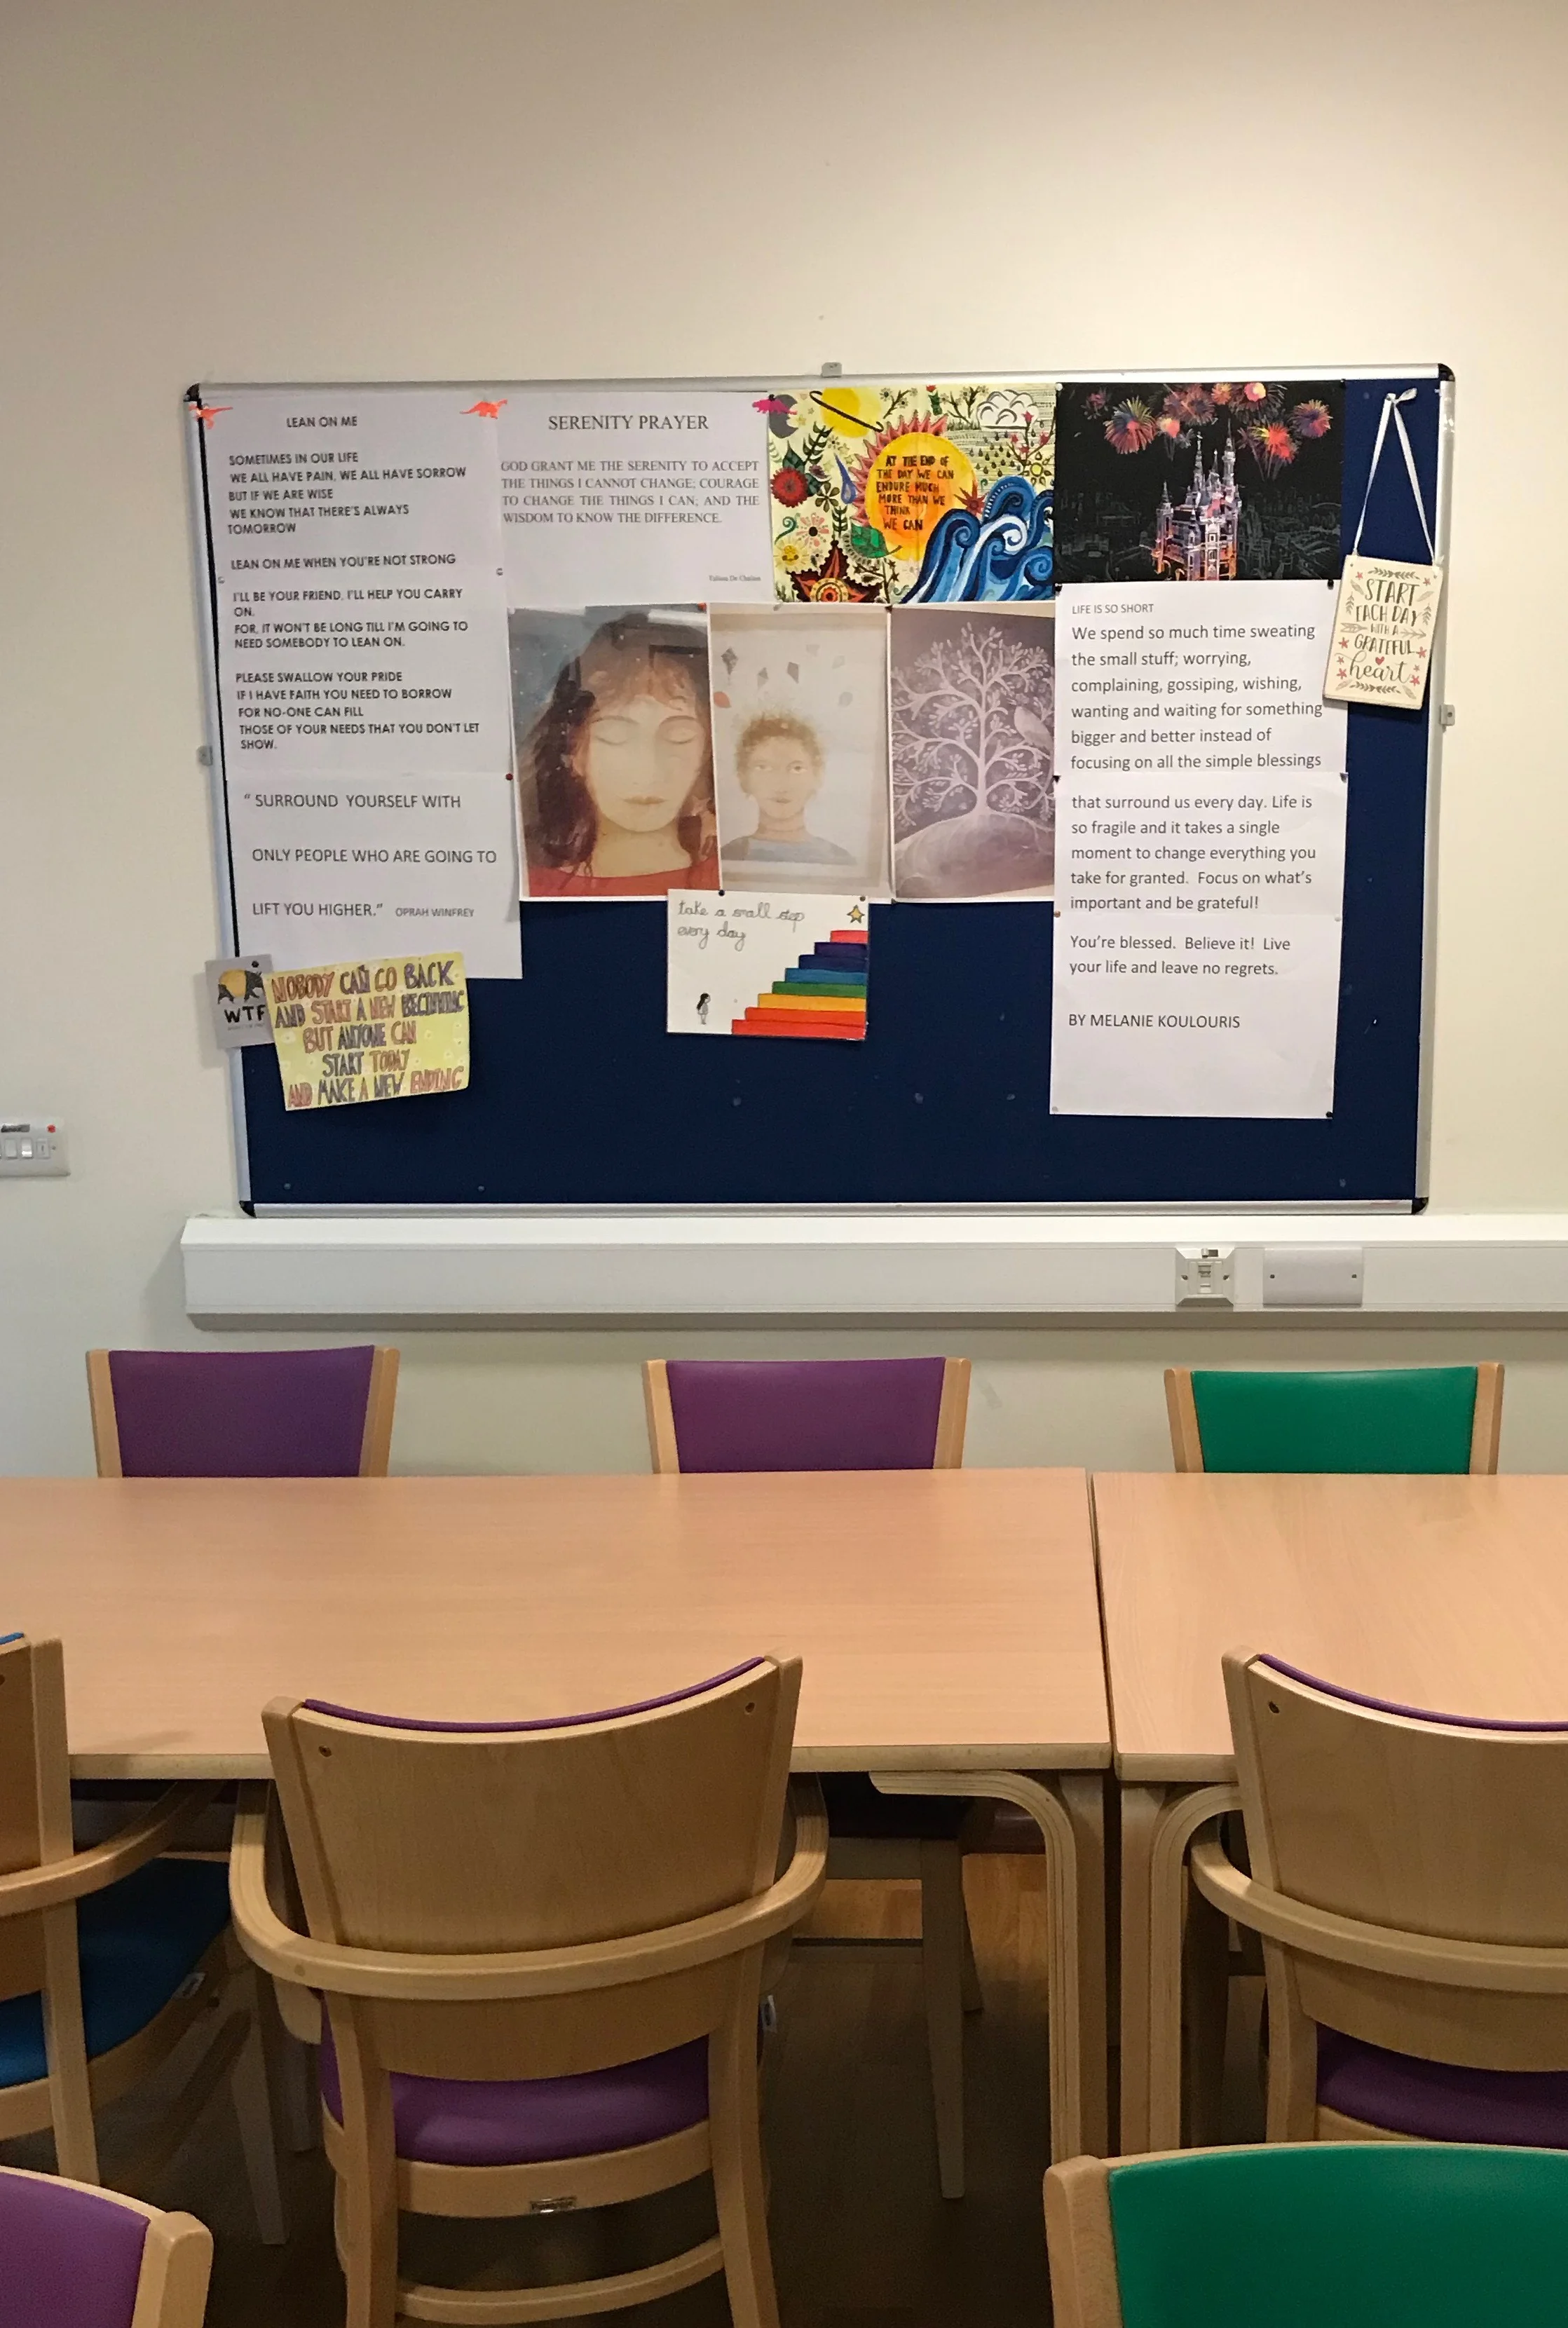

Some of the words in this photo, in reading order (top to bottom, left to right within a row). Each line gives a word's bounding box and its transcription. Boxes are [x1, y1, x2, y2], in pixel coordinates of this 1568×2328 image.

[287, 416, 315, 428] LEAN
[318, 416, 337, 427] ON
[341, 416, 357, 426] ME
[549, 415, 633, 430] SERENITY
[639, 415, 709, 429] PRAYER
[229, 454, 292, 465] SOMETIMES
[295, 454, 307, 463] IN
[311, 453, 334, 463] OUR
[338, 451, 358, 462] LIFE
[500, 461, 528, 471] GOD
[531, 461, 573, 471] GRANT
[577, 461, 595, 470] ME
[599, 461, 622, 470] THE
[627, 461, 686, 470] SERENITY
[691, 461, 708, 470] TO
[711, 461, 758, 471] ACCEPT
[885, 455, 897, 467] AT
[902, 455, 917, 467] THE
[920, 455, 935, 466] END
[940, 456, 949, 467] OF
[877, 469, 892, 479] THE
[897, 469, 913, 479] DAY
[917, 469, 931, 479] WE
[936, 470, 954, 479] CAN
[501, 478, 524, 489] THE
[529, 478, 574, 488] THINGS
[578, 478, 581, 488] I
[585, 478, 636, 488] CANNOT
[699, 478, 758, 488] COURAGE
[876, 482, 910, 493] ENDURE
[915, 482, 939, 492] MUCH
[878, 493, 902, 504] MORE
[908, 494, 929, 505] THAN
[933, 495, 945, 506] WE
[503, 513, 553, 523] WISDOM
[557, 512, 573, 523] TO
[576, 512, 613, 522] KNOW
[617, 512, 641, 522] THE
[885, 505, 911, 516] THINK
[882, 517, 897, 531] WE
[903, 519, 923, 531] CAN
[231, 559, 259, 569] LEAN
[262, 558, 280, 569] ON
[283, 558, 300, 569] ME
[303, 557, 336, 568] WHEN
[339, 556, 380, 567] YOU'RE
[383, 554, 407, 565] NOT
[409, 553, 456, 565] STRONG
[1365, 578, 1420, 606] START
[1072, 605, 1091, 614] LIFE
[1094, 604, 1102, 613] IS
[1105, 604, 1118, 613] SO
[1121, 604, 1154, 613] SHORT
[1356, 604, 1388, 622] EACH
[1391, 606, 1422, 627] DAY
[1072, 627, 1096, 639] We
[1100, 625, 1143, 642] spend
[1148, 629, 1164, 639] so
[1169, 625, 1208, 638] much
[1213, 625, 1246, 638] time
[1250, 624, 1315, 640] sweating
[1370, 623, 1390, 635] WITH
[1392, 625, 1399, 636] A
[235, 638, 263, 648] NEED
[266, 637, 329, 648] SOMEBODY
[333, 637, 348, 647] TO
[351, 637, 380, 647] LEAN
[1354, 634, 1417, 655] GRATEFUL
[1071, 652, 1095, 666] the
[1100, 652, 1136, 665] small
[1141, 651, 1178, 667] stuff;
[1183, 651, 1250, 667] worrying,
[1337, 650, 1412, 683] heart
[236, 672, 274, 683] PLEASE
[277, 672, 333, 683] SWALLOW
[336, 672, 367, 682] YOUR
[371, 672, 402, 681] PRIDE
[1071, 678, 1162, 695] complaining,
[1167, 677, 1237, 694] gossiping,
[1243, 676, 1301, 692] wishing,
[1071, 704, 1129, 721] wanting
[1133, 703, 1159, 717] and
[1164, 703, 1216, 719] waiting
[1221, 702, 1241, 716] for
[1246, 701, 1322, 718] something
[1071, 730, 1115, 747] bigger
[1119, 729, 1145, 742] and
[1151, 728, 1195, 742] better
[1200, 728, 1251, 742] instead
[1257, 727, 1272, 741] of
[1070, 755, 1130, 772] focusing
[1134, 758, 1152, 768] on
[1157, 754, 1173, 768] all
[1178, 754, 1201, 768] the
[1206, 754, 1252, 770] simple
[1257, 753, 1321, 769] blessings
[252, 848, 290, 862] ONLY
[295, 849, 347, 862] PEOPLE
[352, 849, 388, 862] WHO
[393, 850, 421, 862] ARE
[424, 850, 472, 863] GOING
[477, 850, 496, 863] TO
[1070, 871, 1101, 884] take
[1105, 871, 1126, 884] for
[1129, 871, 1188, 887] granted.
[1198, 871, 1238, 884] Focus
[1242, 874, 1260, 884] on
[252, 902, 280, 915] LIFT
[284, 903, 313, 915] YOU
[395, 907, 429, 917] OPRAH
[431, 908, 474, 917] WINFREY
[678, 900, 709, 916] take
[714, 908, 726, 917] a
[1071, 897, 1141, 911] important
[1145, 896, 1171, 908] and
[1176, 896, 1193, 908] be
[1197, 895, 1257, 912] grateful!
[716, 920, 746, 951] day
[271, 972, 335, 1004] NOBODY
[340, 965, 371, 995] CAN
[404, 960, 454, 989] BACK
[224, 1005, 266, 1023] WTF
[275, 1004, 306, 1028] AND
[311, 999, 351, 1024] START
[357, 998, 367, 1021] A
[369, 994, 395, 1020] NEW
[1069, 1014, 1086, 1026] BY
[1091, 1014, 1153, 1027] MELANIE
[1158, 1015, 1239, 1028] KOULOURIS
[303, 1026, 334, 1054] BUT
[390, 1021, 417, 1045] CAN
[322, 1051, 364, 1077] START
[288, 1082, 313, 1108] AND
[318, 1076, 355, 1105] MAKE
[359, 1077, 369, 1101] A
[374, 1071, 405, 1098] NEW
